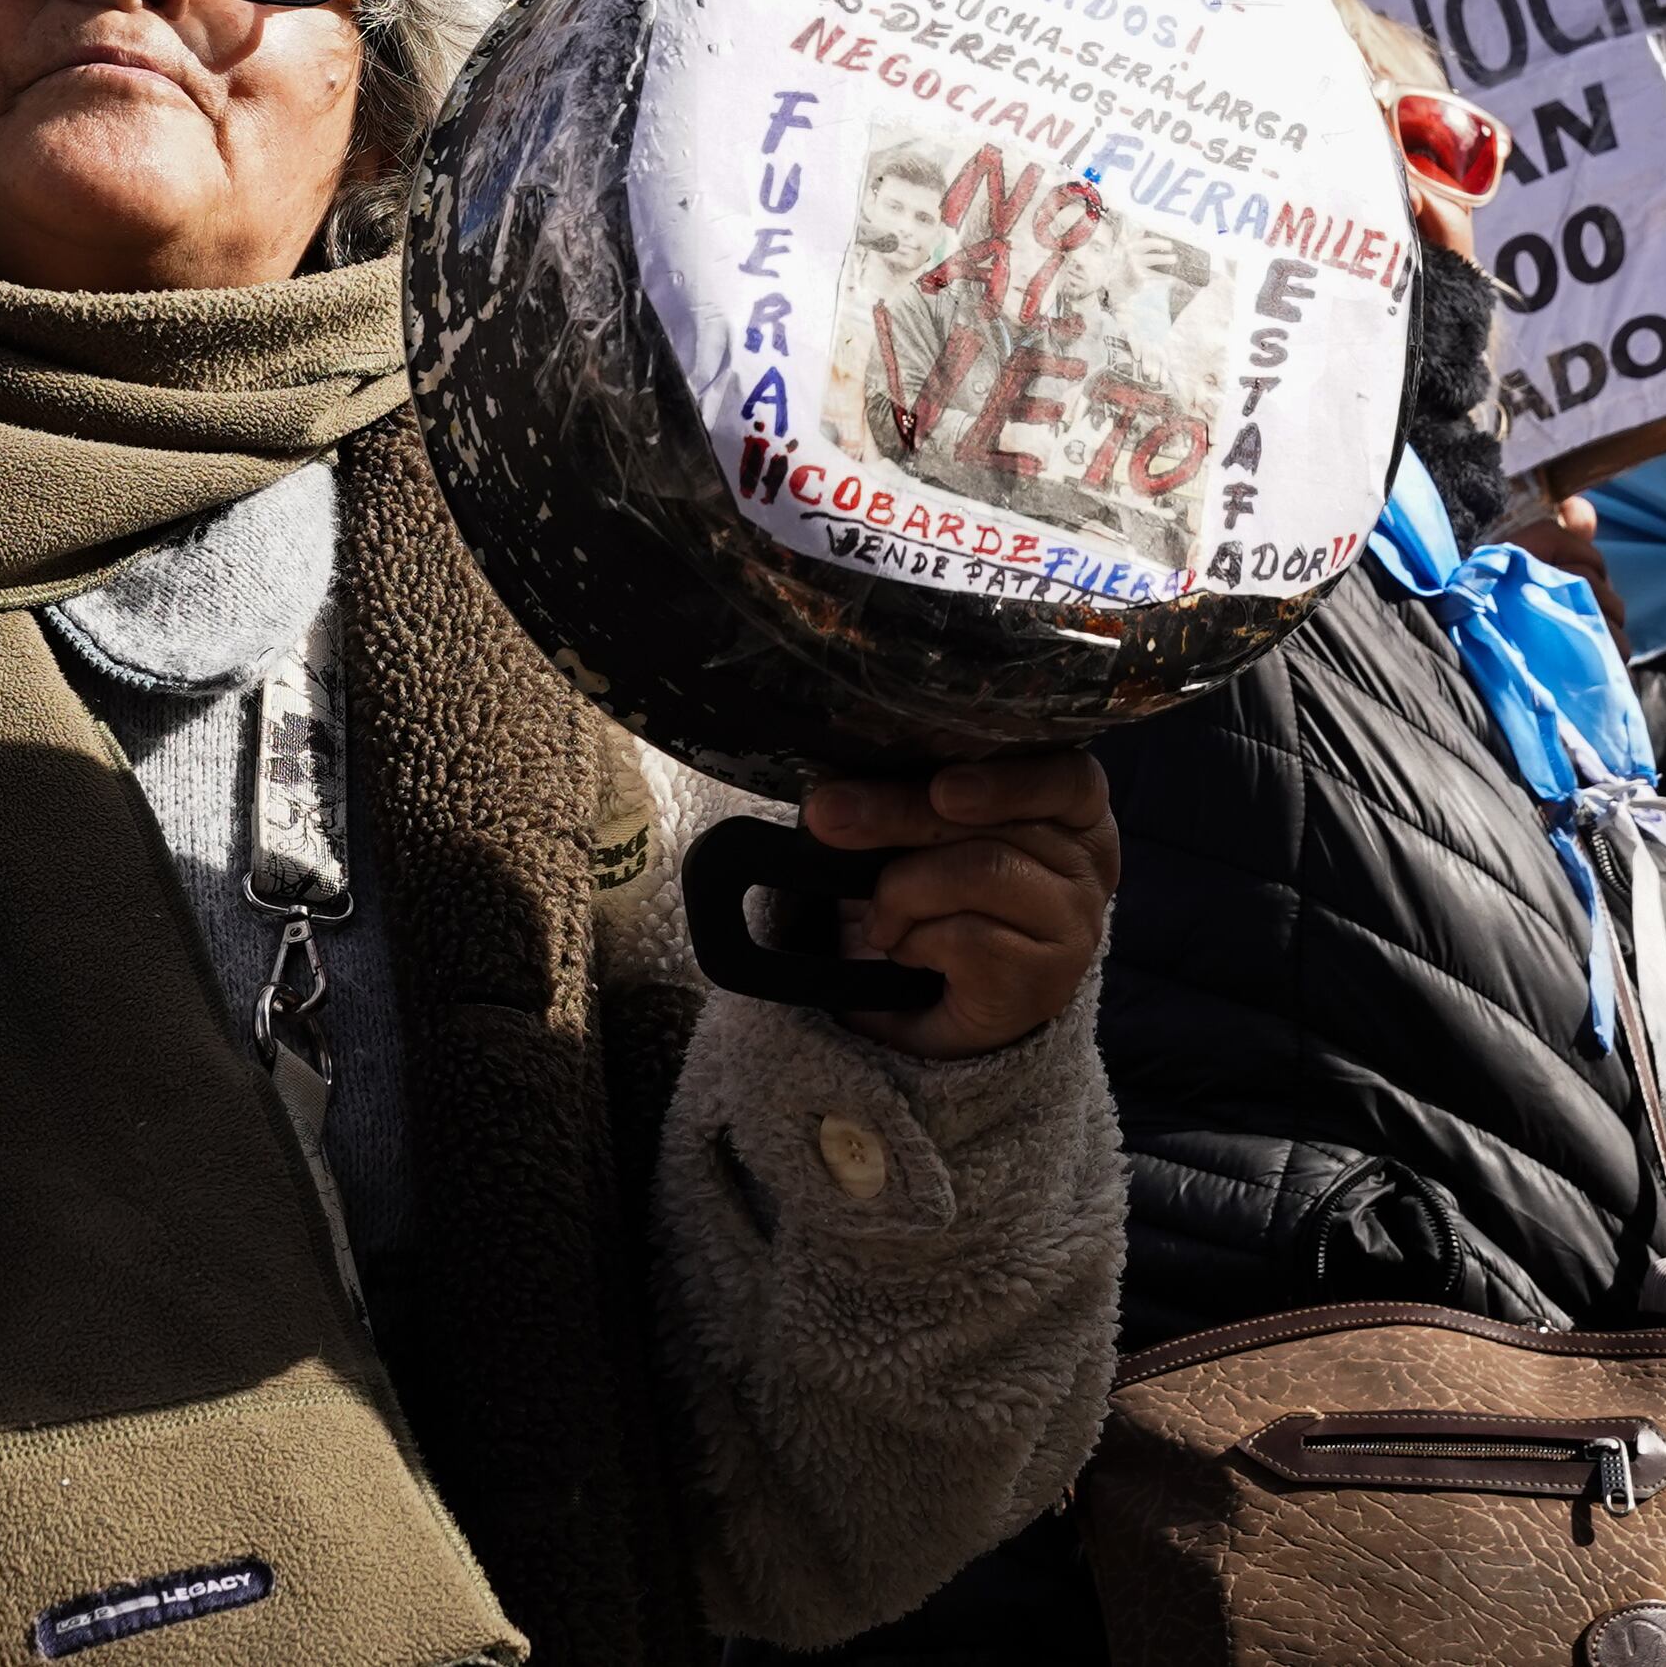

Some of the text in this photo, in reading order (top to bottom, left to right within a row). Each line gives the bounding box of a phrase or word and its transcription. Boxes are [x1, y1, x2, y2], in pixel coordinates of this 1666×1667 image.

[940, 143, 1105, 251] NO
[739, 90, 819, 438] FUERA
[913, 237, 1087, 337] AL
[873, 299, 1210, 497] VETO
[161, 1573, 251, 1603] LEGACY
